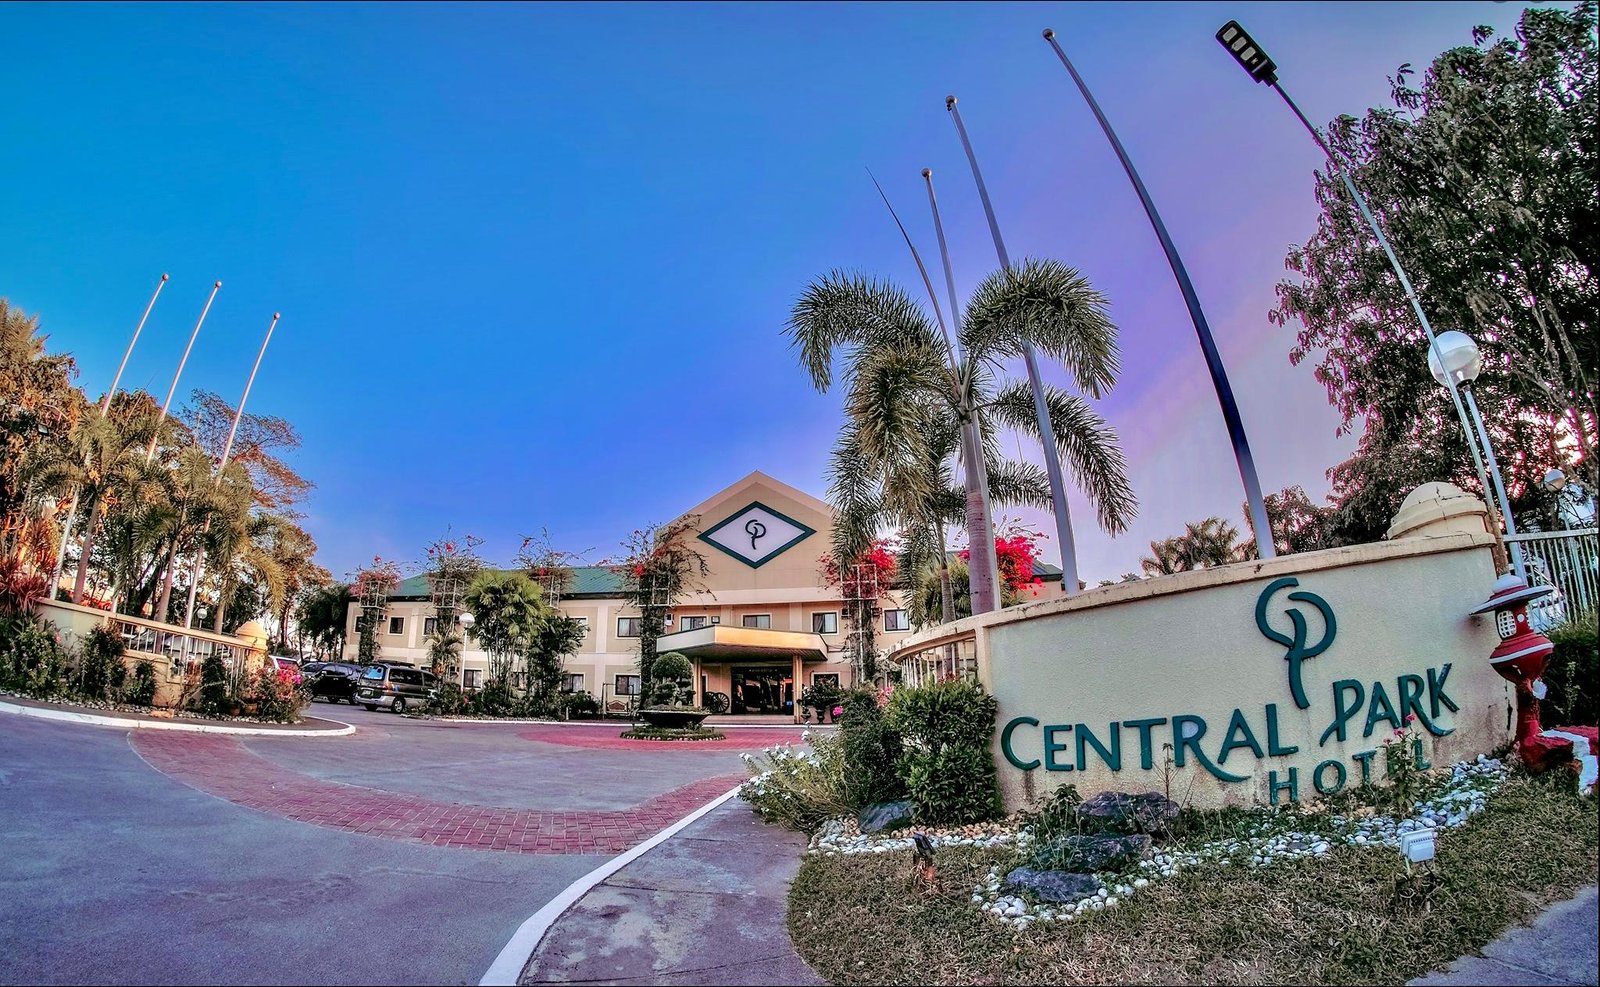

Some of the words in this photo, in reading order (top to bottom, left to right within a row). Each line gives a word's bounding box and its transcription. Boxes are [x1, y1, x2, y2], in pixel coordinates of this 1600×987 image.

[1001, 703, 1299, 782] CENTRAL
[1319, 663, 1460, 748] PARK
[1268, 739, 1431, 804] HOTL
